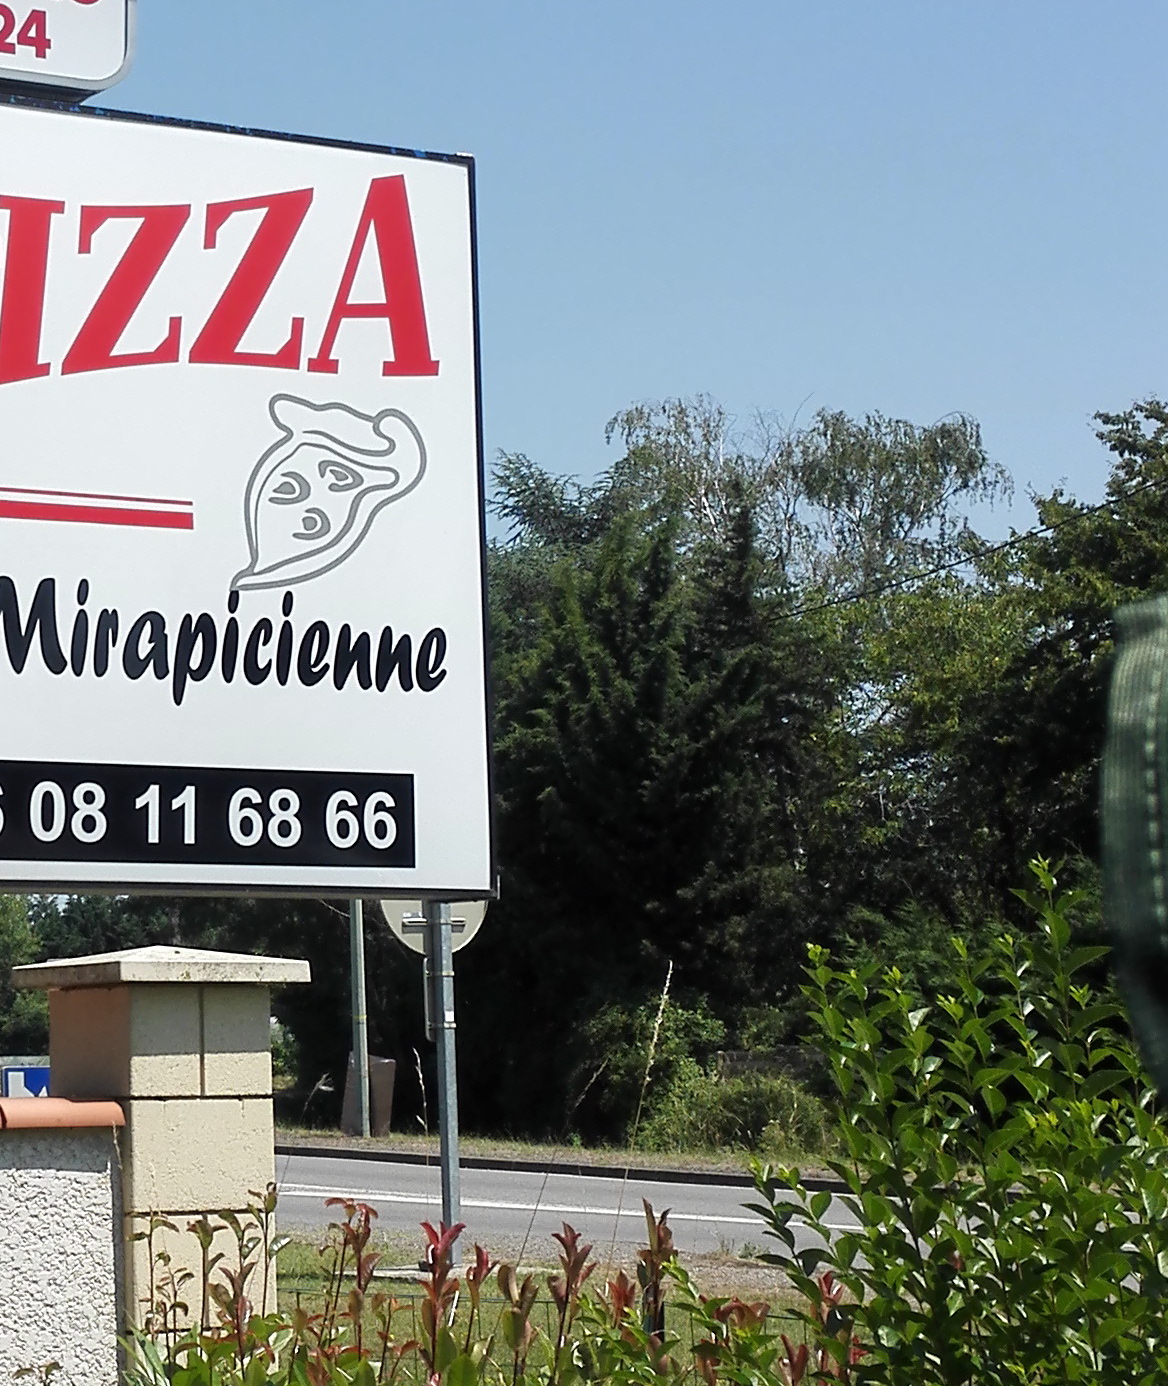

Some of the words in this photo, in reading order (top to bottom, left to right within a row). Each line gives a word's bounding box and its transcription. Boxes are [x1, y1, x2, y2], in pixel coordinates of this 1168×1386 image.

[29, 780, 107, 843] 08
[135, 784, 198, 845] 11
[228, 787, 302, 848] 68
[325, 790, 398, 850] 66
